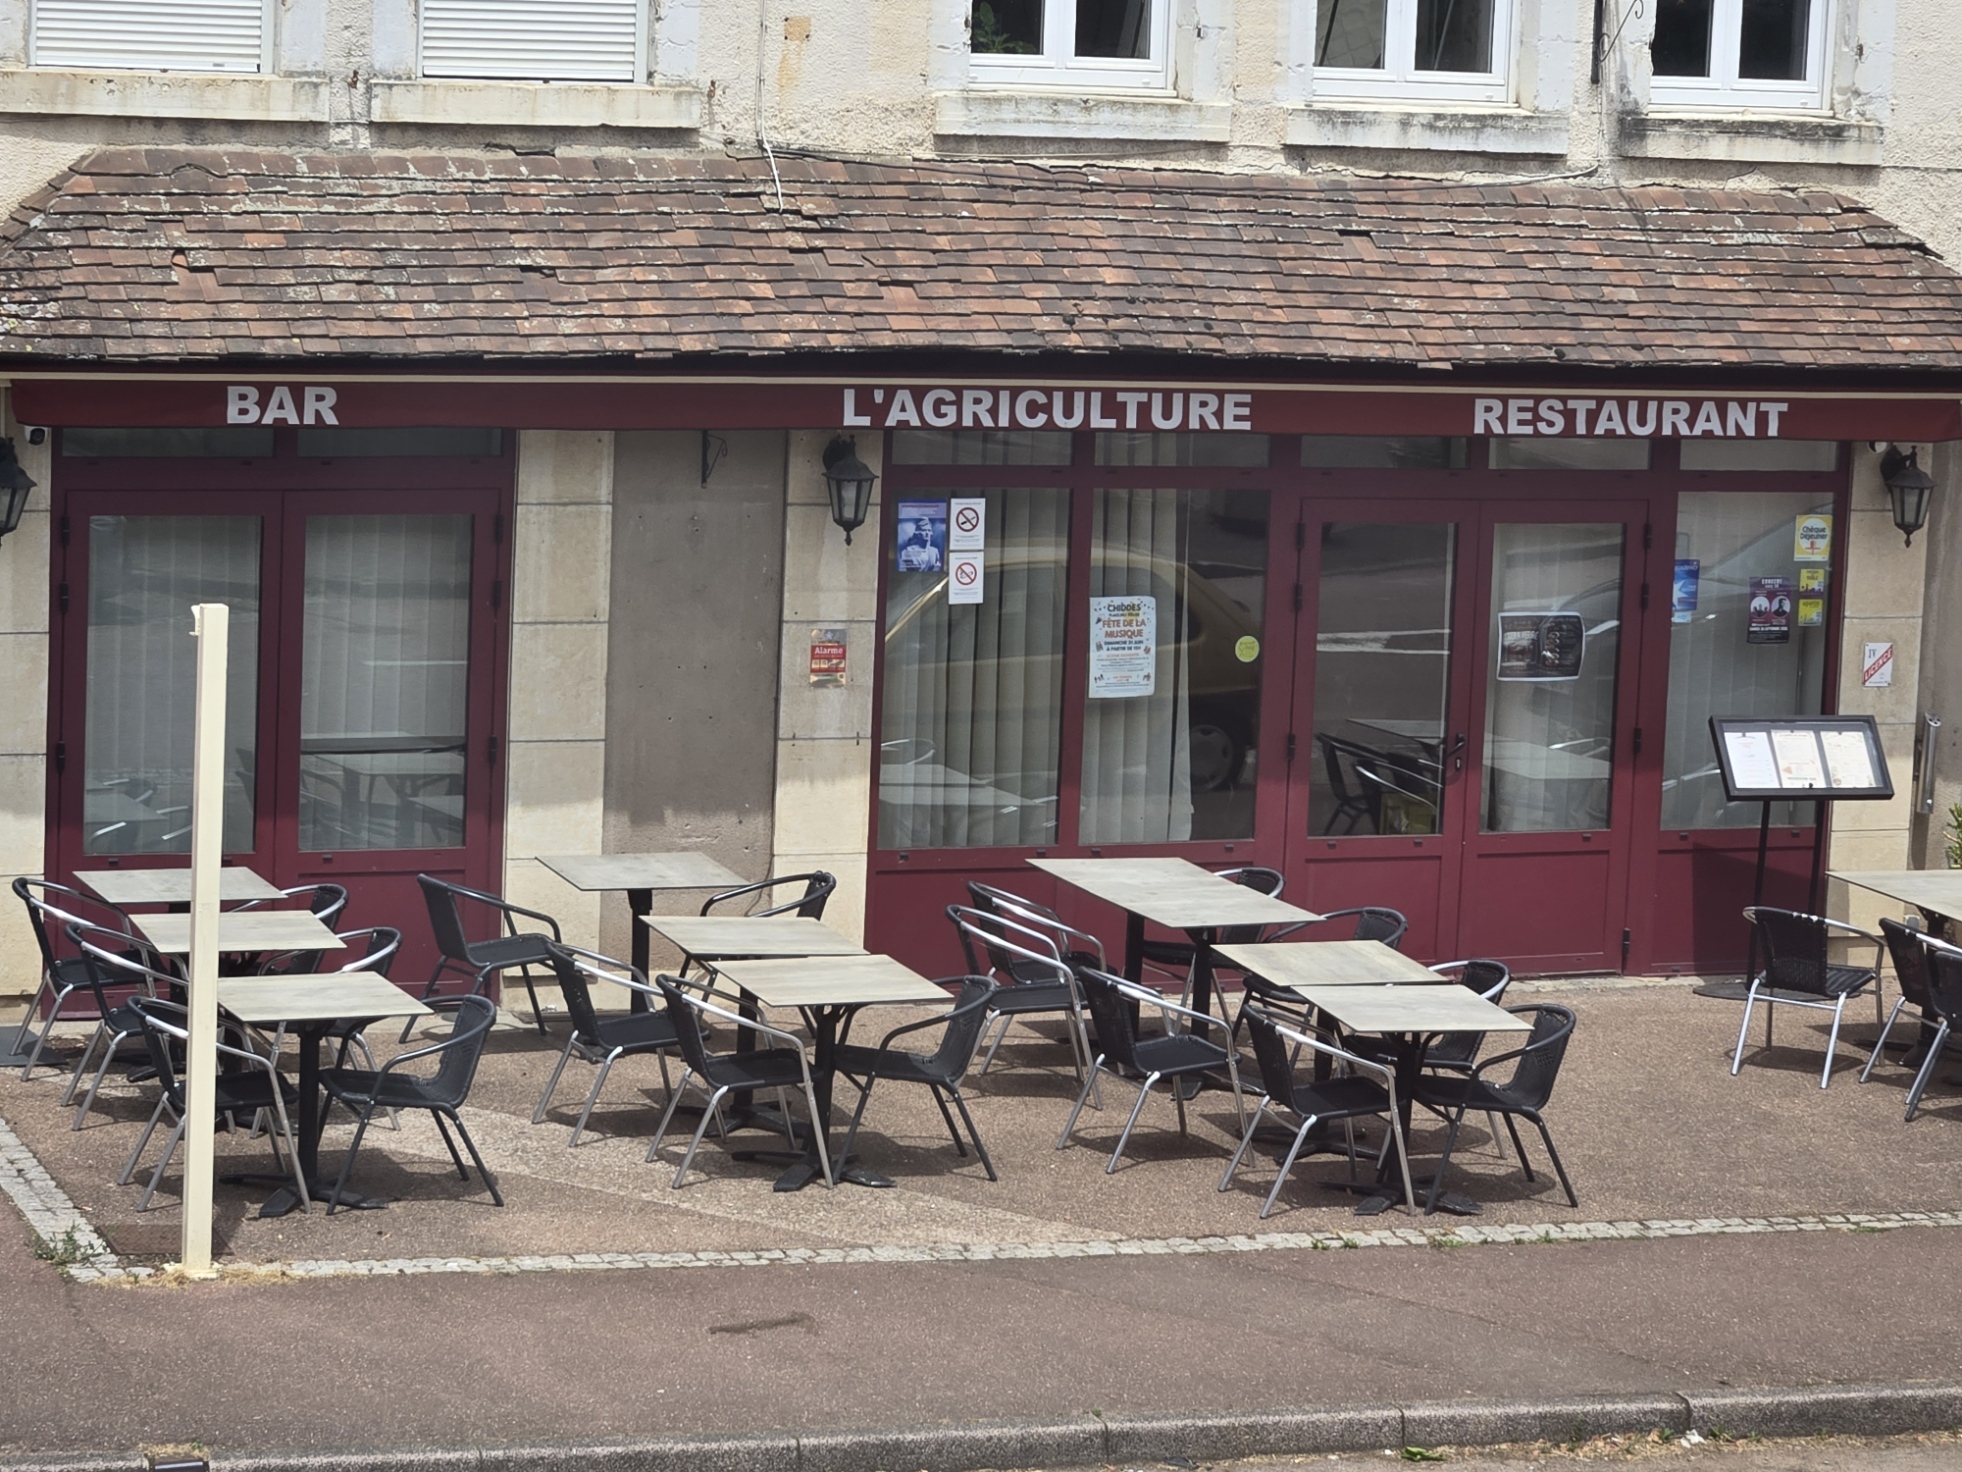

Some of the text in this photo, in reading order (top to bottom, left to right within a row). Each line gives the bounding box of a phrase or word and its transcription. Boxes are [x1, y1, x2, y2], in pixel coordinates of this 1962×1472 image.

[227, 386, 339, 425] BAR
[843, 388, 1252, 430] L'AGRICULTURE
[1473, 398, 1789, 437] RESTAURANT
[1802, 525, 1826, 533] Chèque
[1102, 618, 1146, 628] FÊTE DE LA
[1104, 629, 1143, 639] MUSIQUE
[1864, 646, 1893, 681] LICENCE
[1868, 649, 1877, 658] IV
